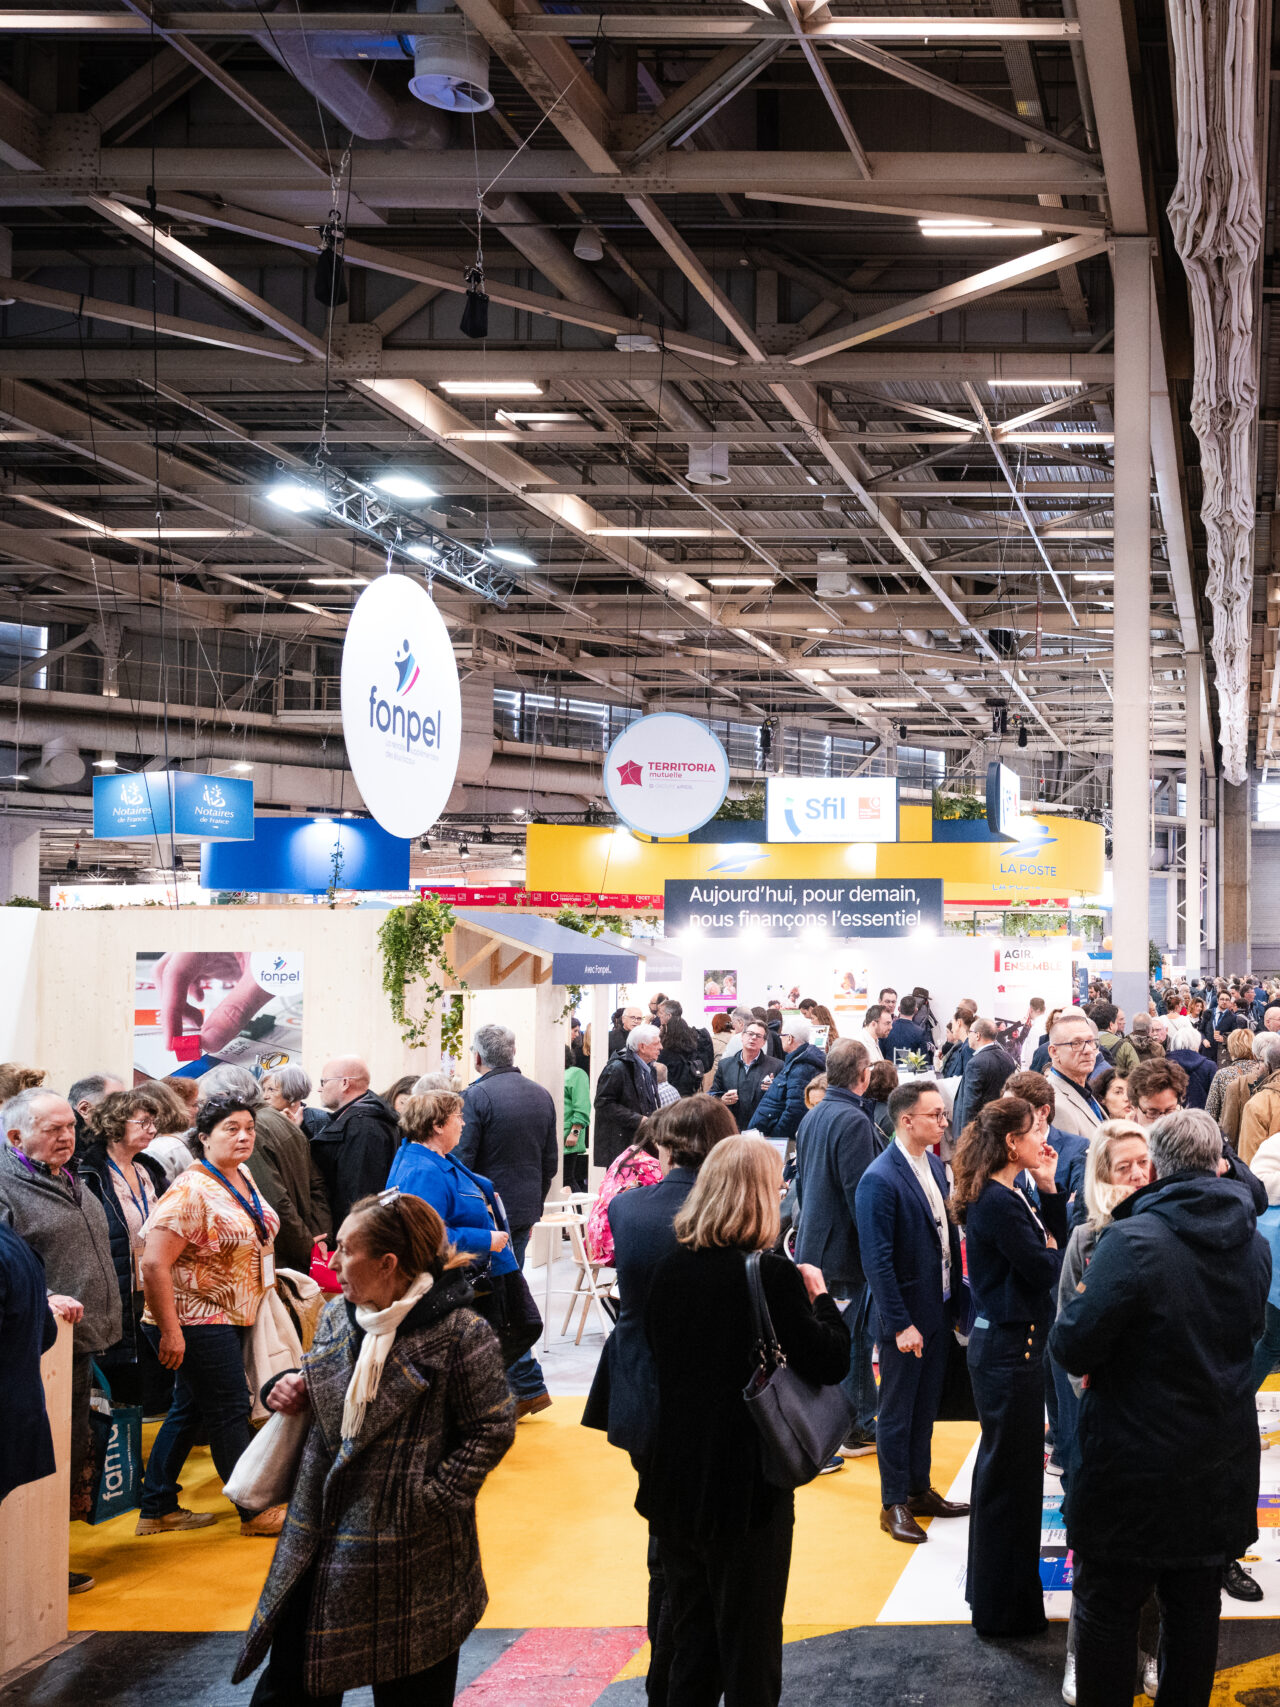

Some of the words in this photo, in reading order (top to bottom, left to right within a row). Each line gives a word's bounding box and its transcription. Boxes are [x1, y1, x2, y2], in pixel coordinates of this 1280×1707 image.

[369, 685, 441, 753] fonpel
[648, 762, 716, 772] TERRITORIA
[649, 771, 682, 779] mutuelle
[112, 807, 152, 817] Notaires
[194, 806, 234, 818] Notaires
[805, 797, 845, 819] Sfil
[127, 815, 147, 823] France
[210, 816, 230, 825] France
[1000, 863, 1017, 873] LA
[1019, 864, 1057, 877] POSTE
[803, 888, 845, 905] pour
[849, 885, 921, 905] demain,
[689, 913, 734, 927] nous
[738, 911, 827, 930] finançons
[261, 971, 300, 984] fonpel
